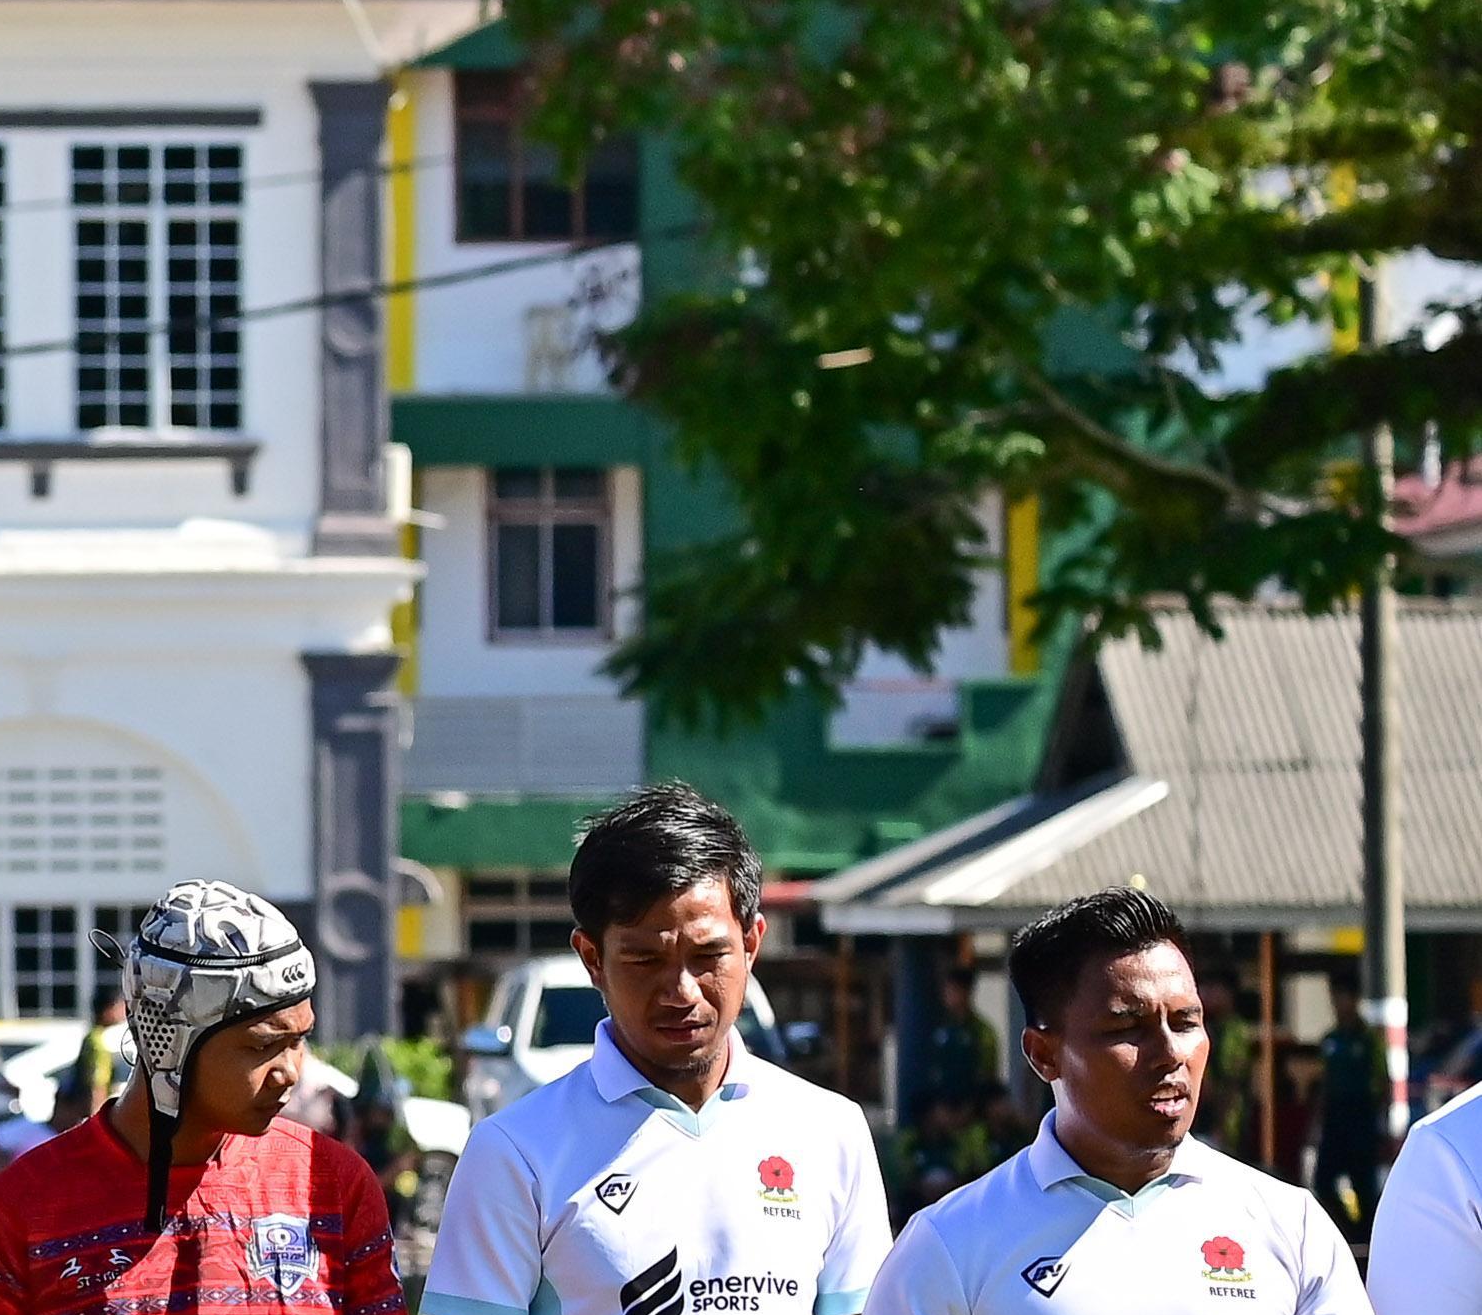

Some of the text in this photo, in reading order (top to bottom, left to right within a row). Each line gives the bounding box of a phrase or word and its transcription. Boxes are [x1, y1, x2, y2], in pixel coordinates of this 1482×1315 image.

[689, 1271, 798, 1297] enervive
[1209, 1286, 1256, 1299] REFEREE
[692, 1295, 759, 1312] SPORTS
